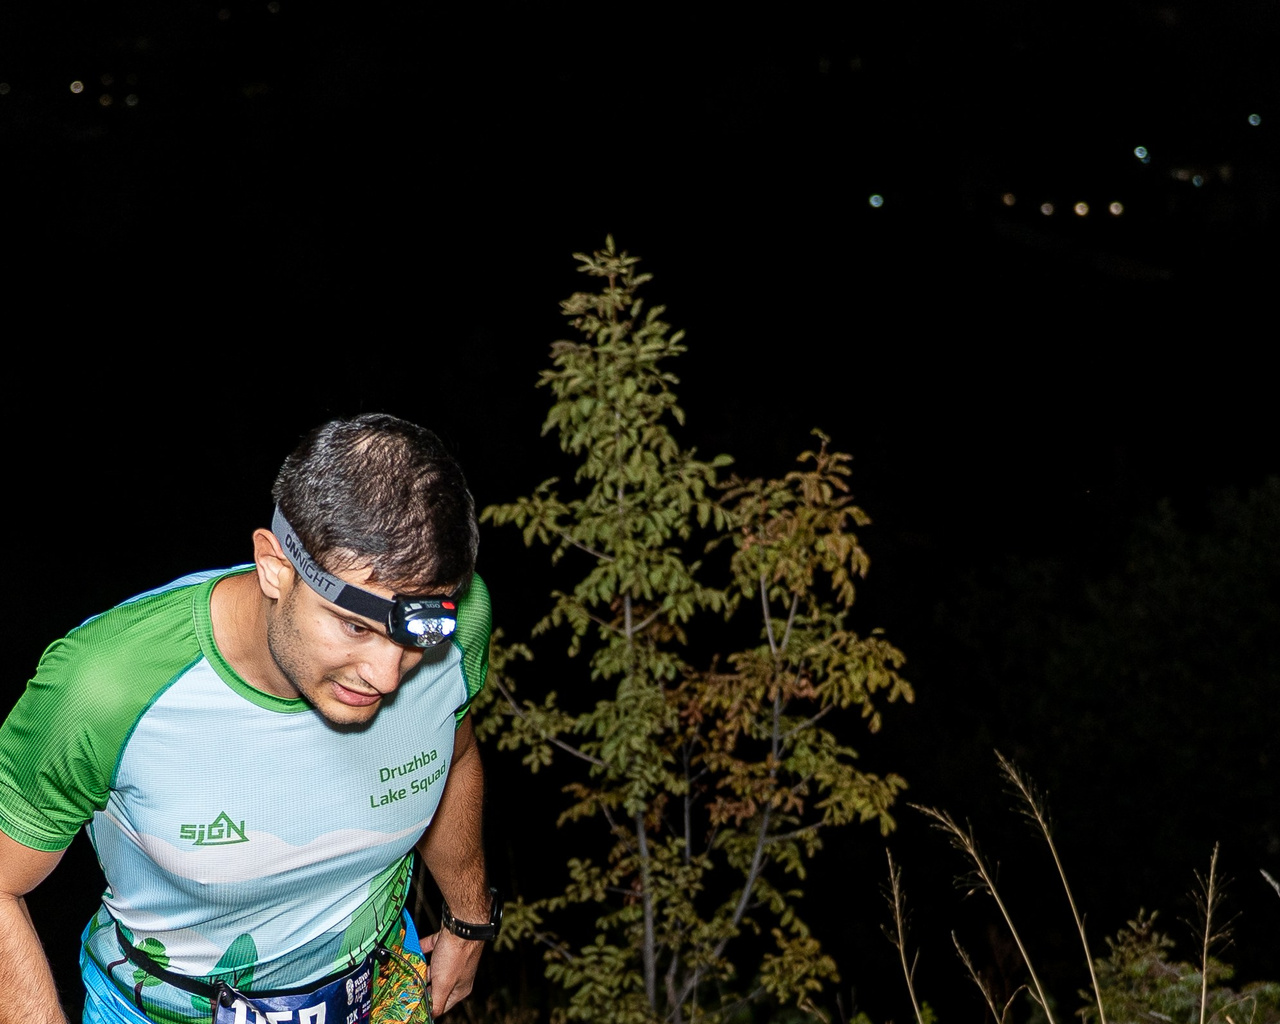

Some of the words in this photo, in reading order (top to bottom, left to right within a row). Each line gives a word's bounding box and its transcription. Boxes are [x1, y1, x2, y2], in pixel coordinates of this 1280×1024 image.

[284, 533, 336, 593] ONNIGHT
[370, 788, 407, 808] Lake
[410, 759, 446, 795] Squad
[379, 747, 438, 783] Druzhba
